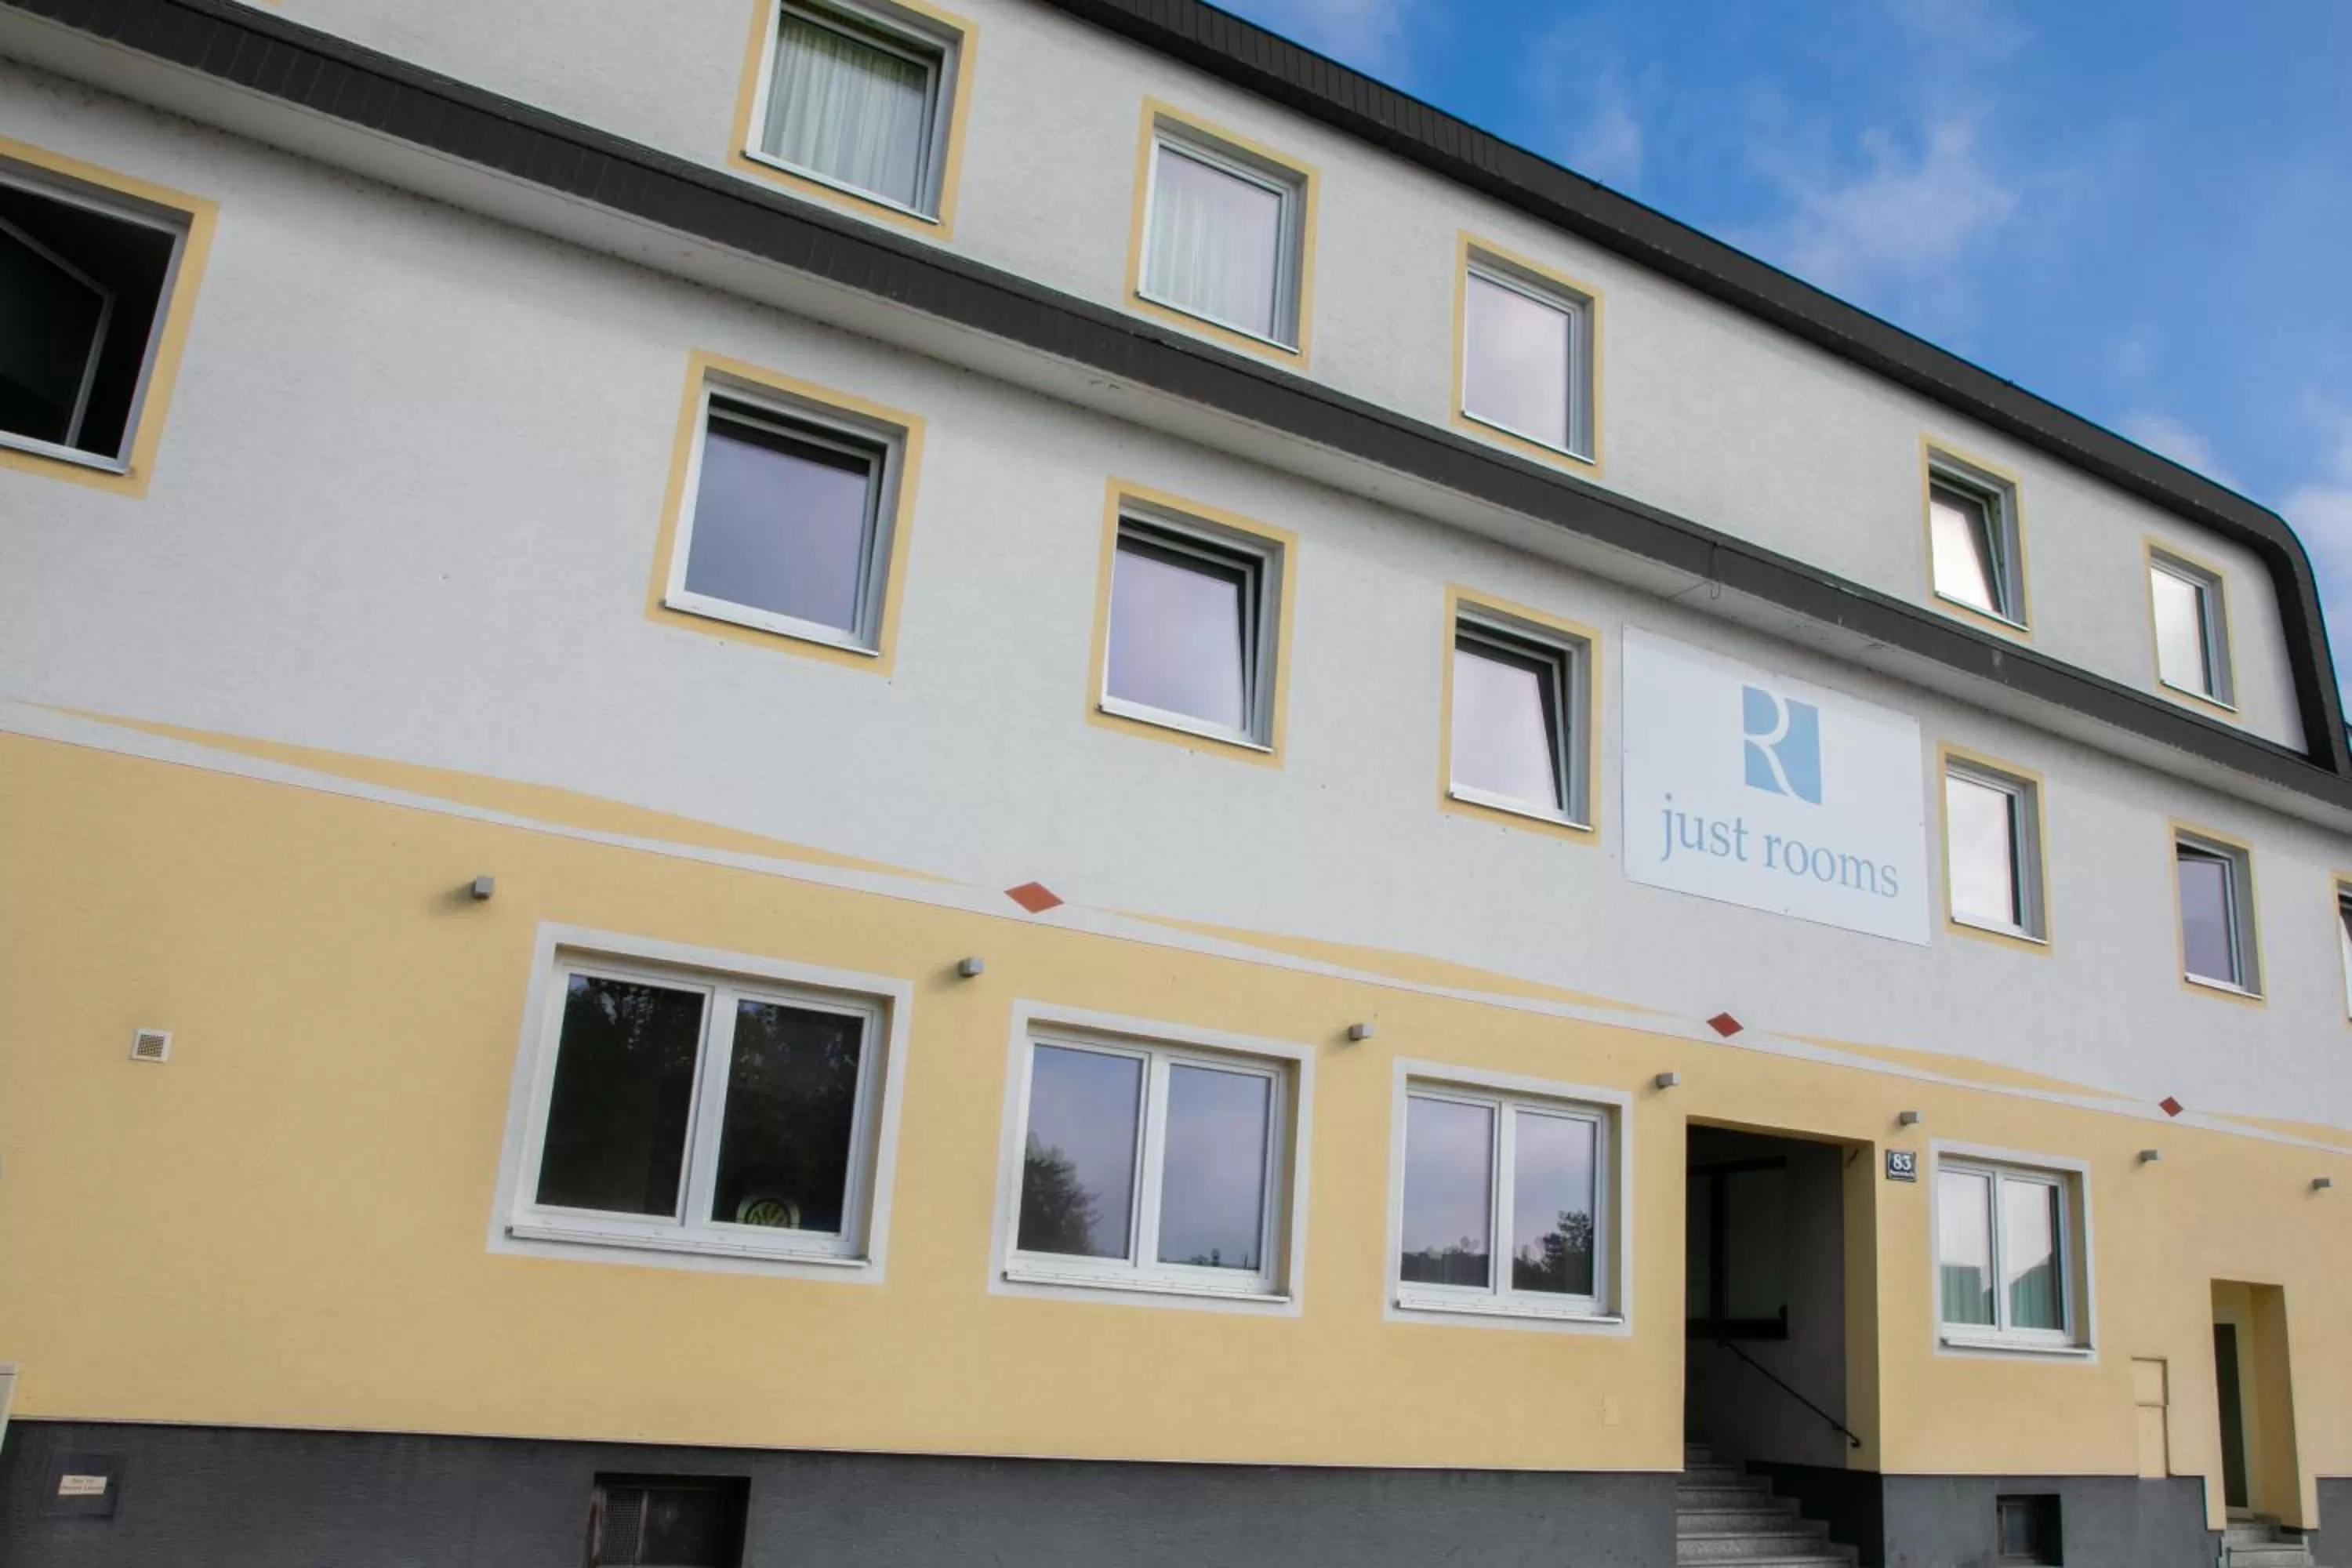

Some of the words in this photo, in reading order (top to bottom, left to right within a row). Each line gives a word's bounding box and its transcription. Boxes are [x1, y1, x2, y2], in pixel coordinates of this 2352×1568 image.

[1742, 684, 1822, 806] R
[1661, 793, 1749, 862] just
[1763, 833, 1899, 898] rooms
[1893, 1153, 1911, 1171] 83
